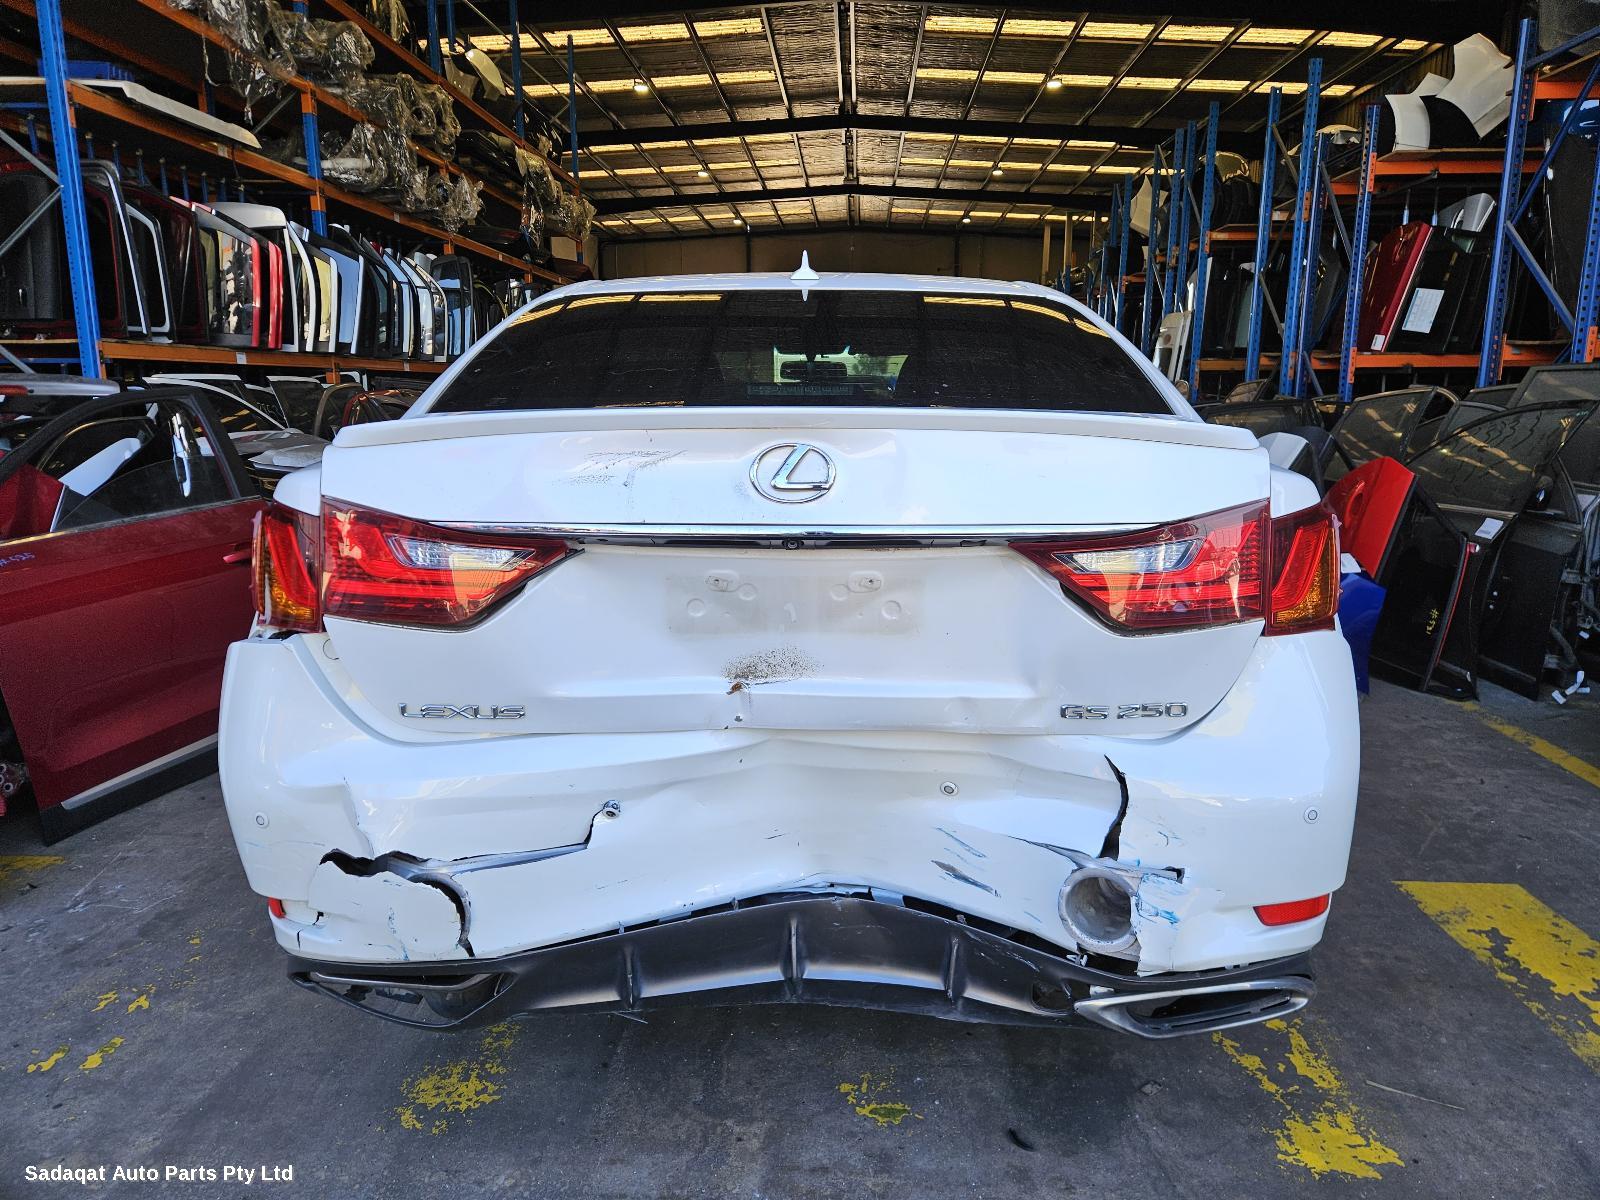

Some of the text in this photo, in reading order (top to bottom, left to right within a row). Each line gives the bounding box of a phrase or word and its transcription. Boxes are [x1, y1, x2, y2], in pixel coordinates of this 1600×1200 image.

[398, 702, 526, 720] LEXUS
[1059, 702, 1188, 719] GS 250
